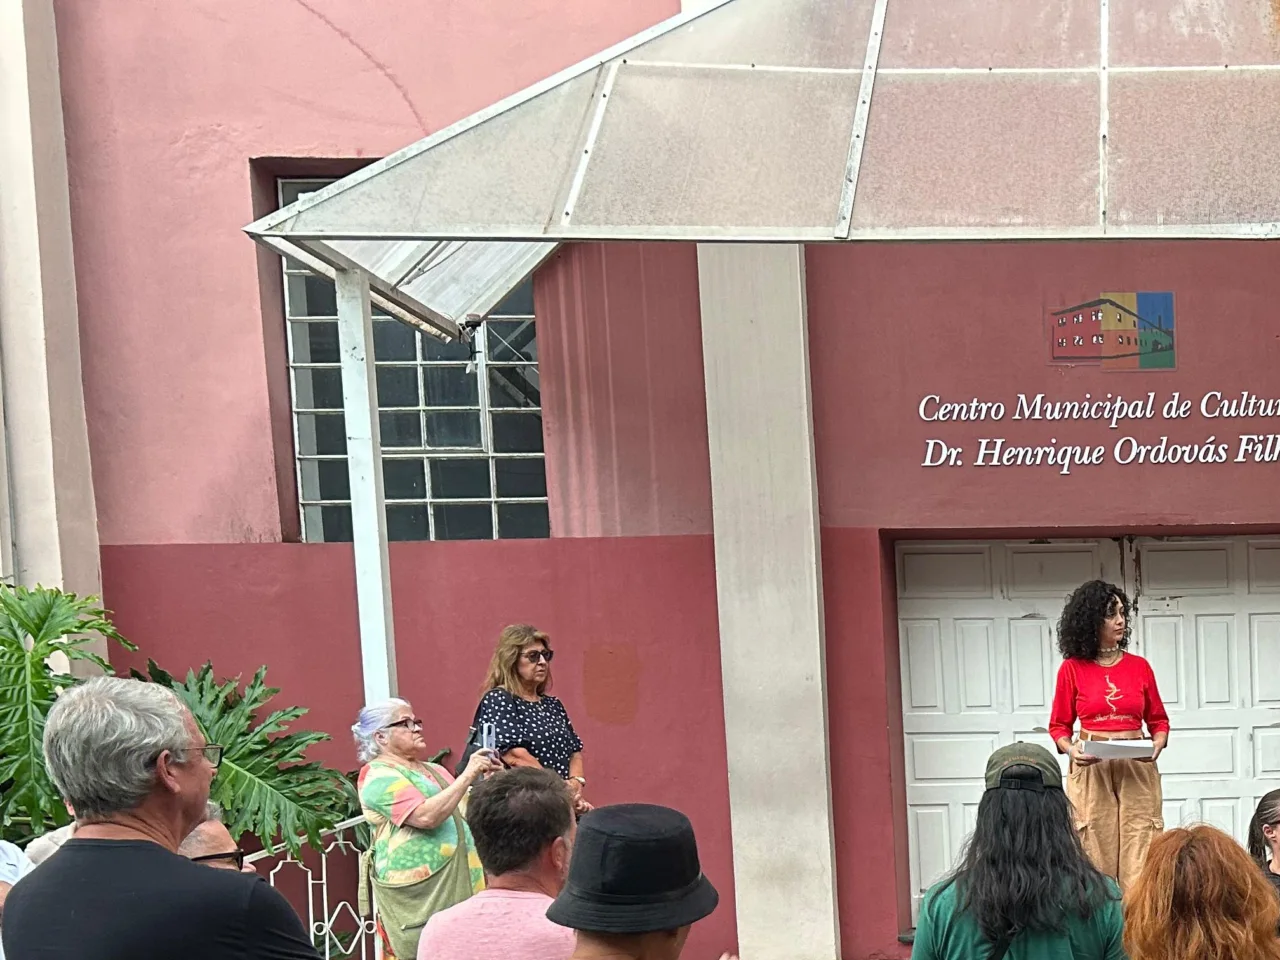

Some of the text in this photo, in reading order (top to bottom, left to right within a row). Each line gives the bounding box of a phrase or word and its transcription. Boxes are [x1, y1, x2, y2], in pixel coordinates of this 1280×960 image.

[918, 394, 1005, 422] Centro
[1011, 391, 1156, 429] Municipal
[1162, 391, 1192, 419] de
[920, 439, 963, 467] Dr.
[973, 438, 1105, 475] Henrique
[1113, 436, 1229, 465] Ordovás
